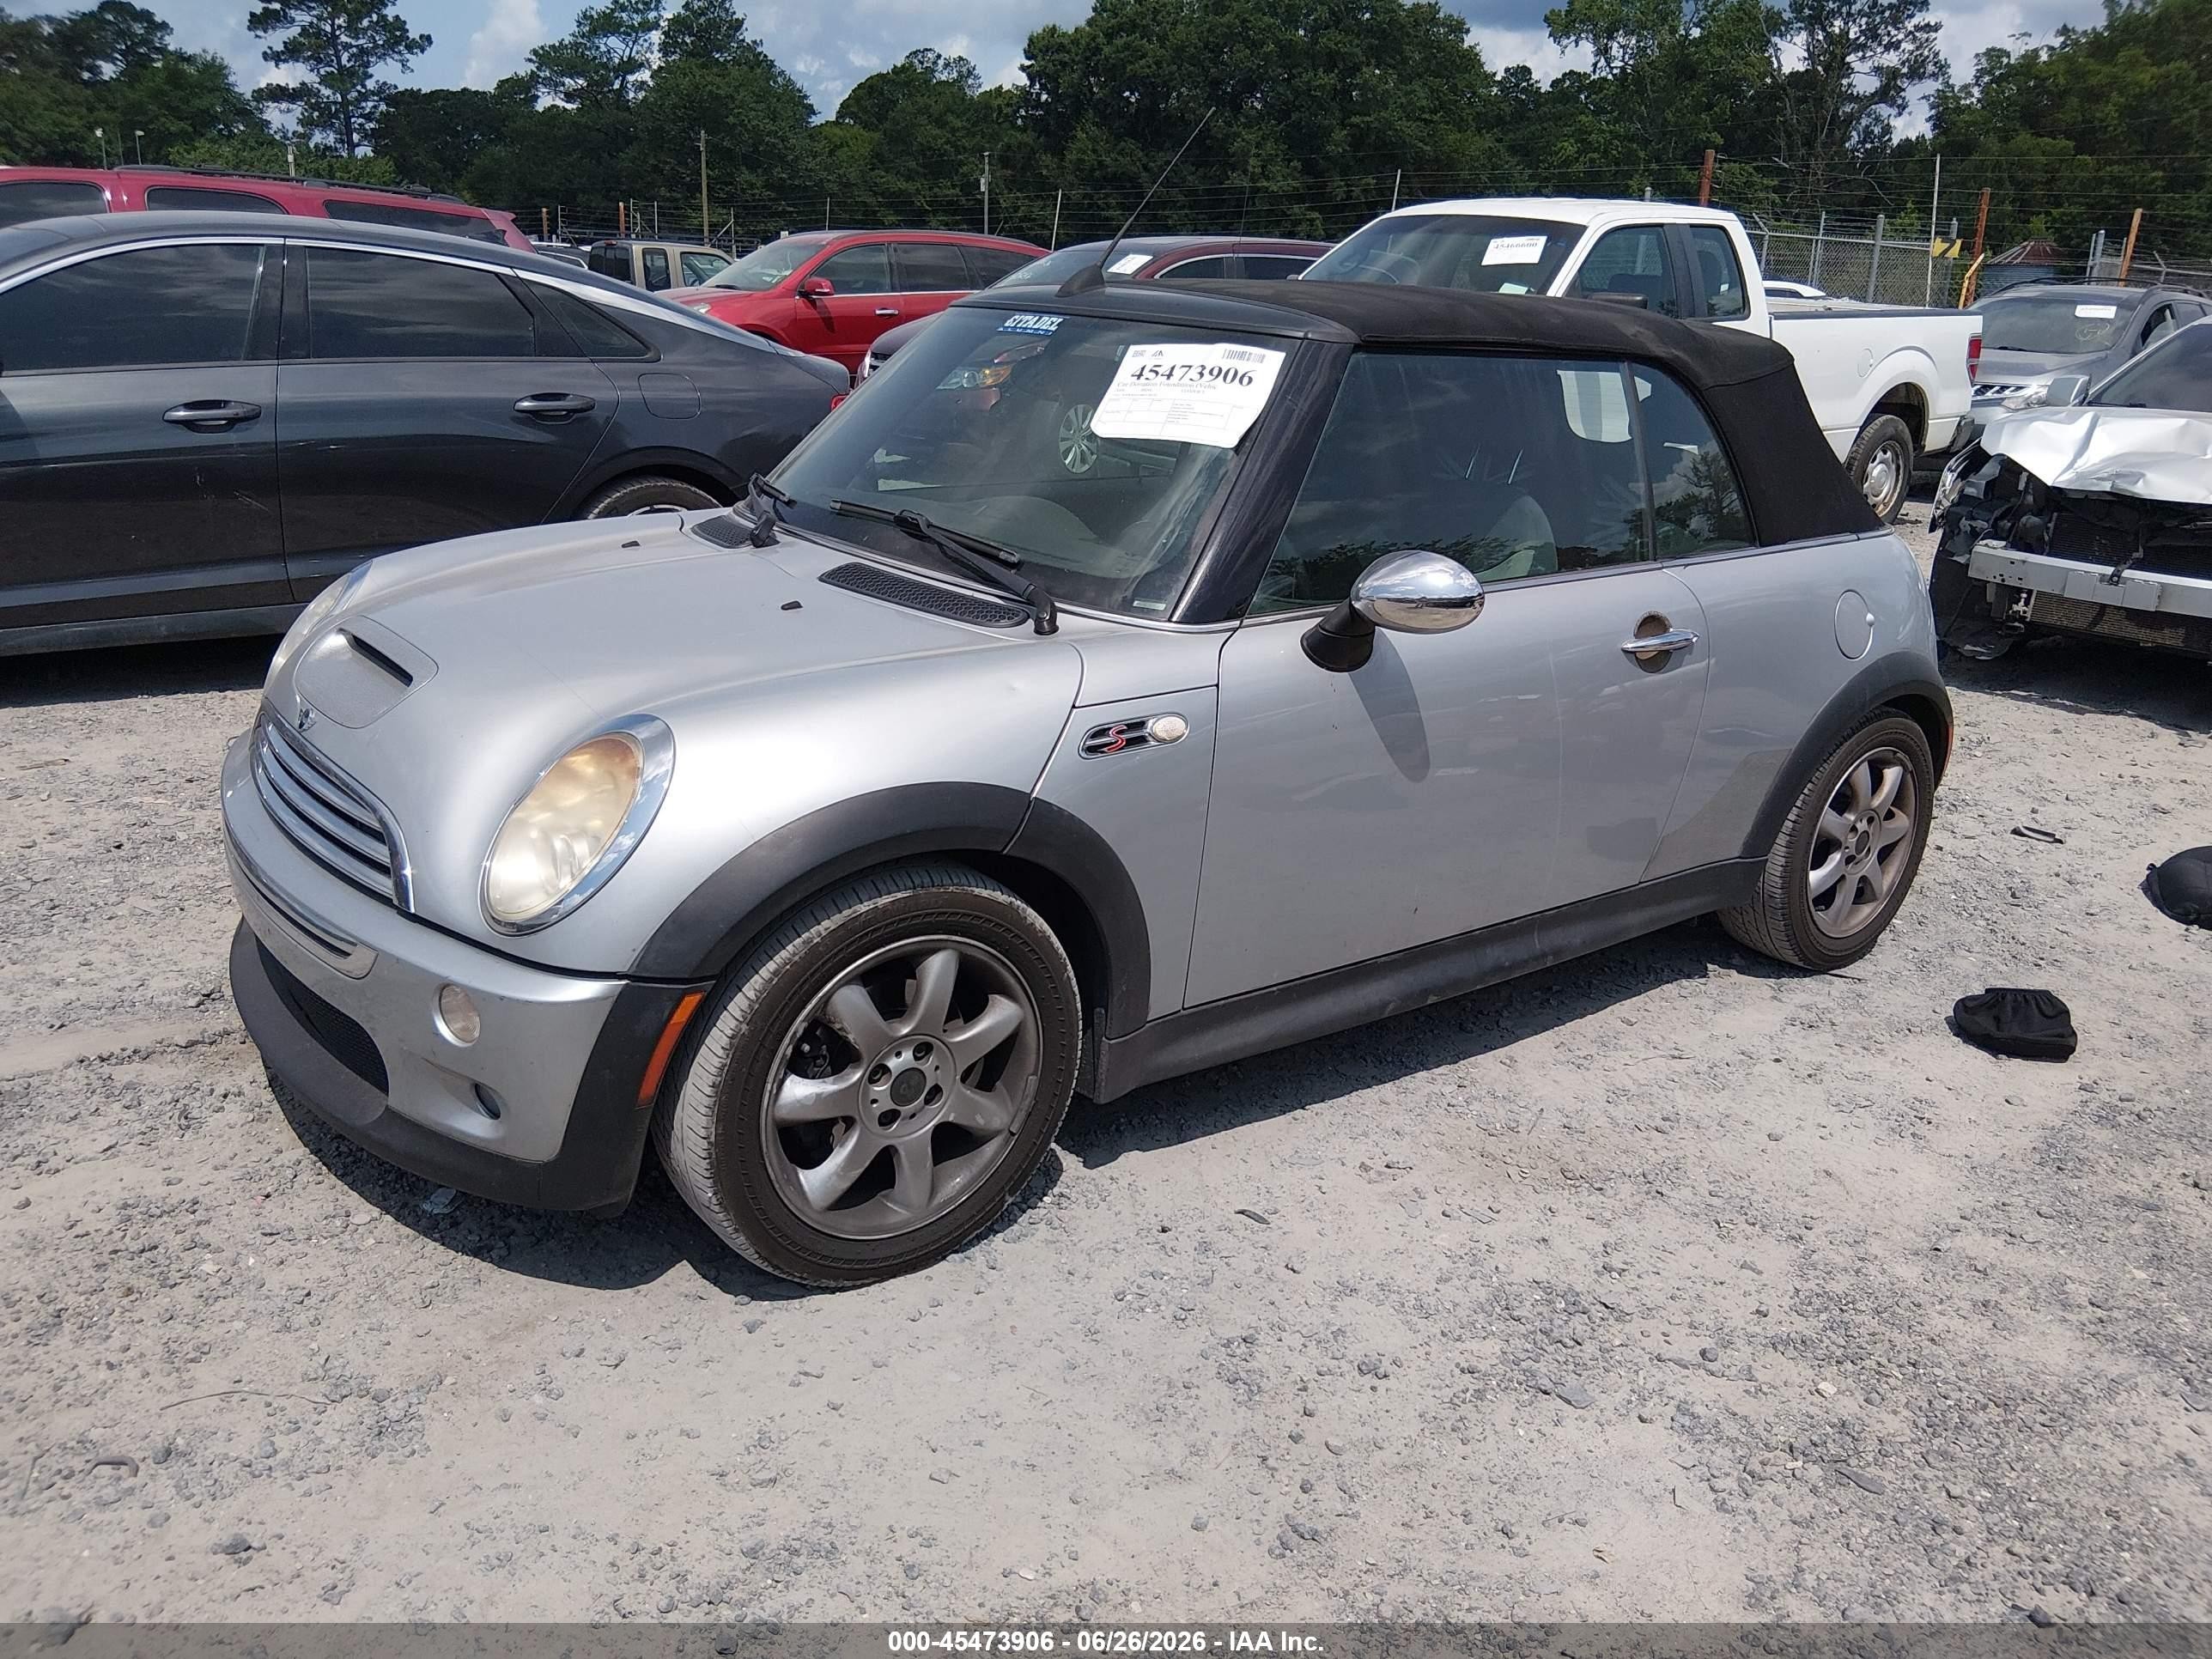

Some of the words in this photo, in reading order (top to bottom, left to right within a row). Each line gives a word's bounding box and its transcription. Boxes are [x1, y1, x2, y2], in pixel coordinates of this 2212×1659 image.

[1003, 315, 1064, 331] CITADEL
[1130, 364, 1257, 386] 45473906
[1103, 724, 1127, 753] S
